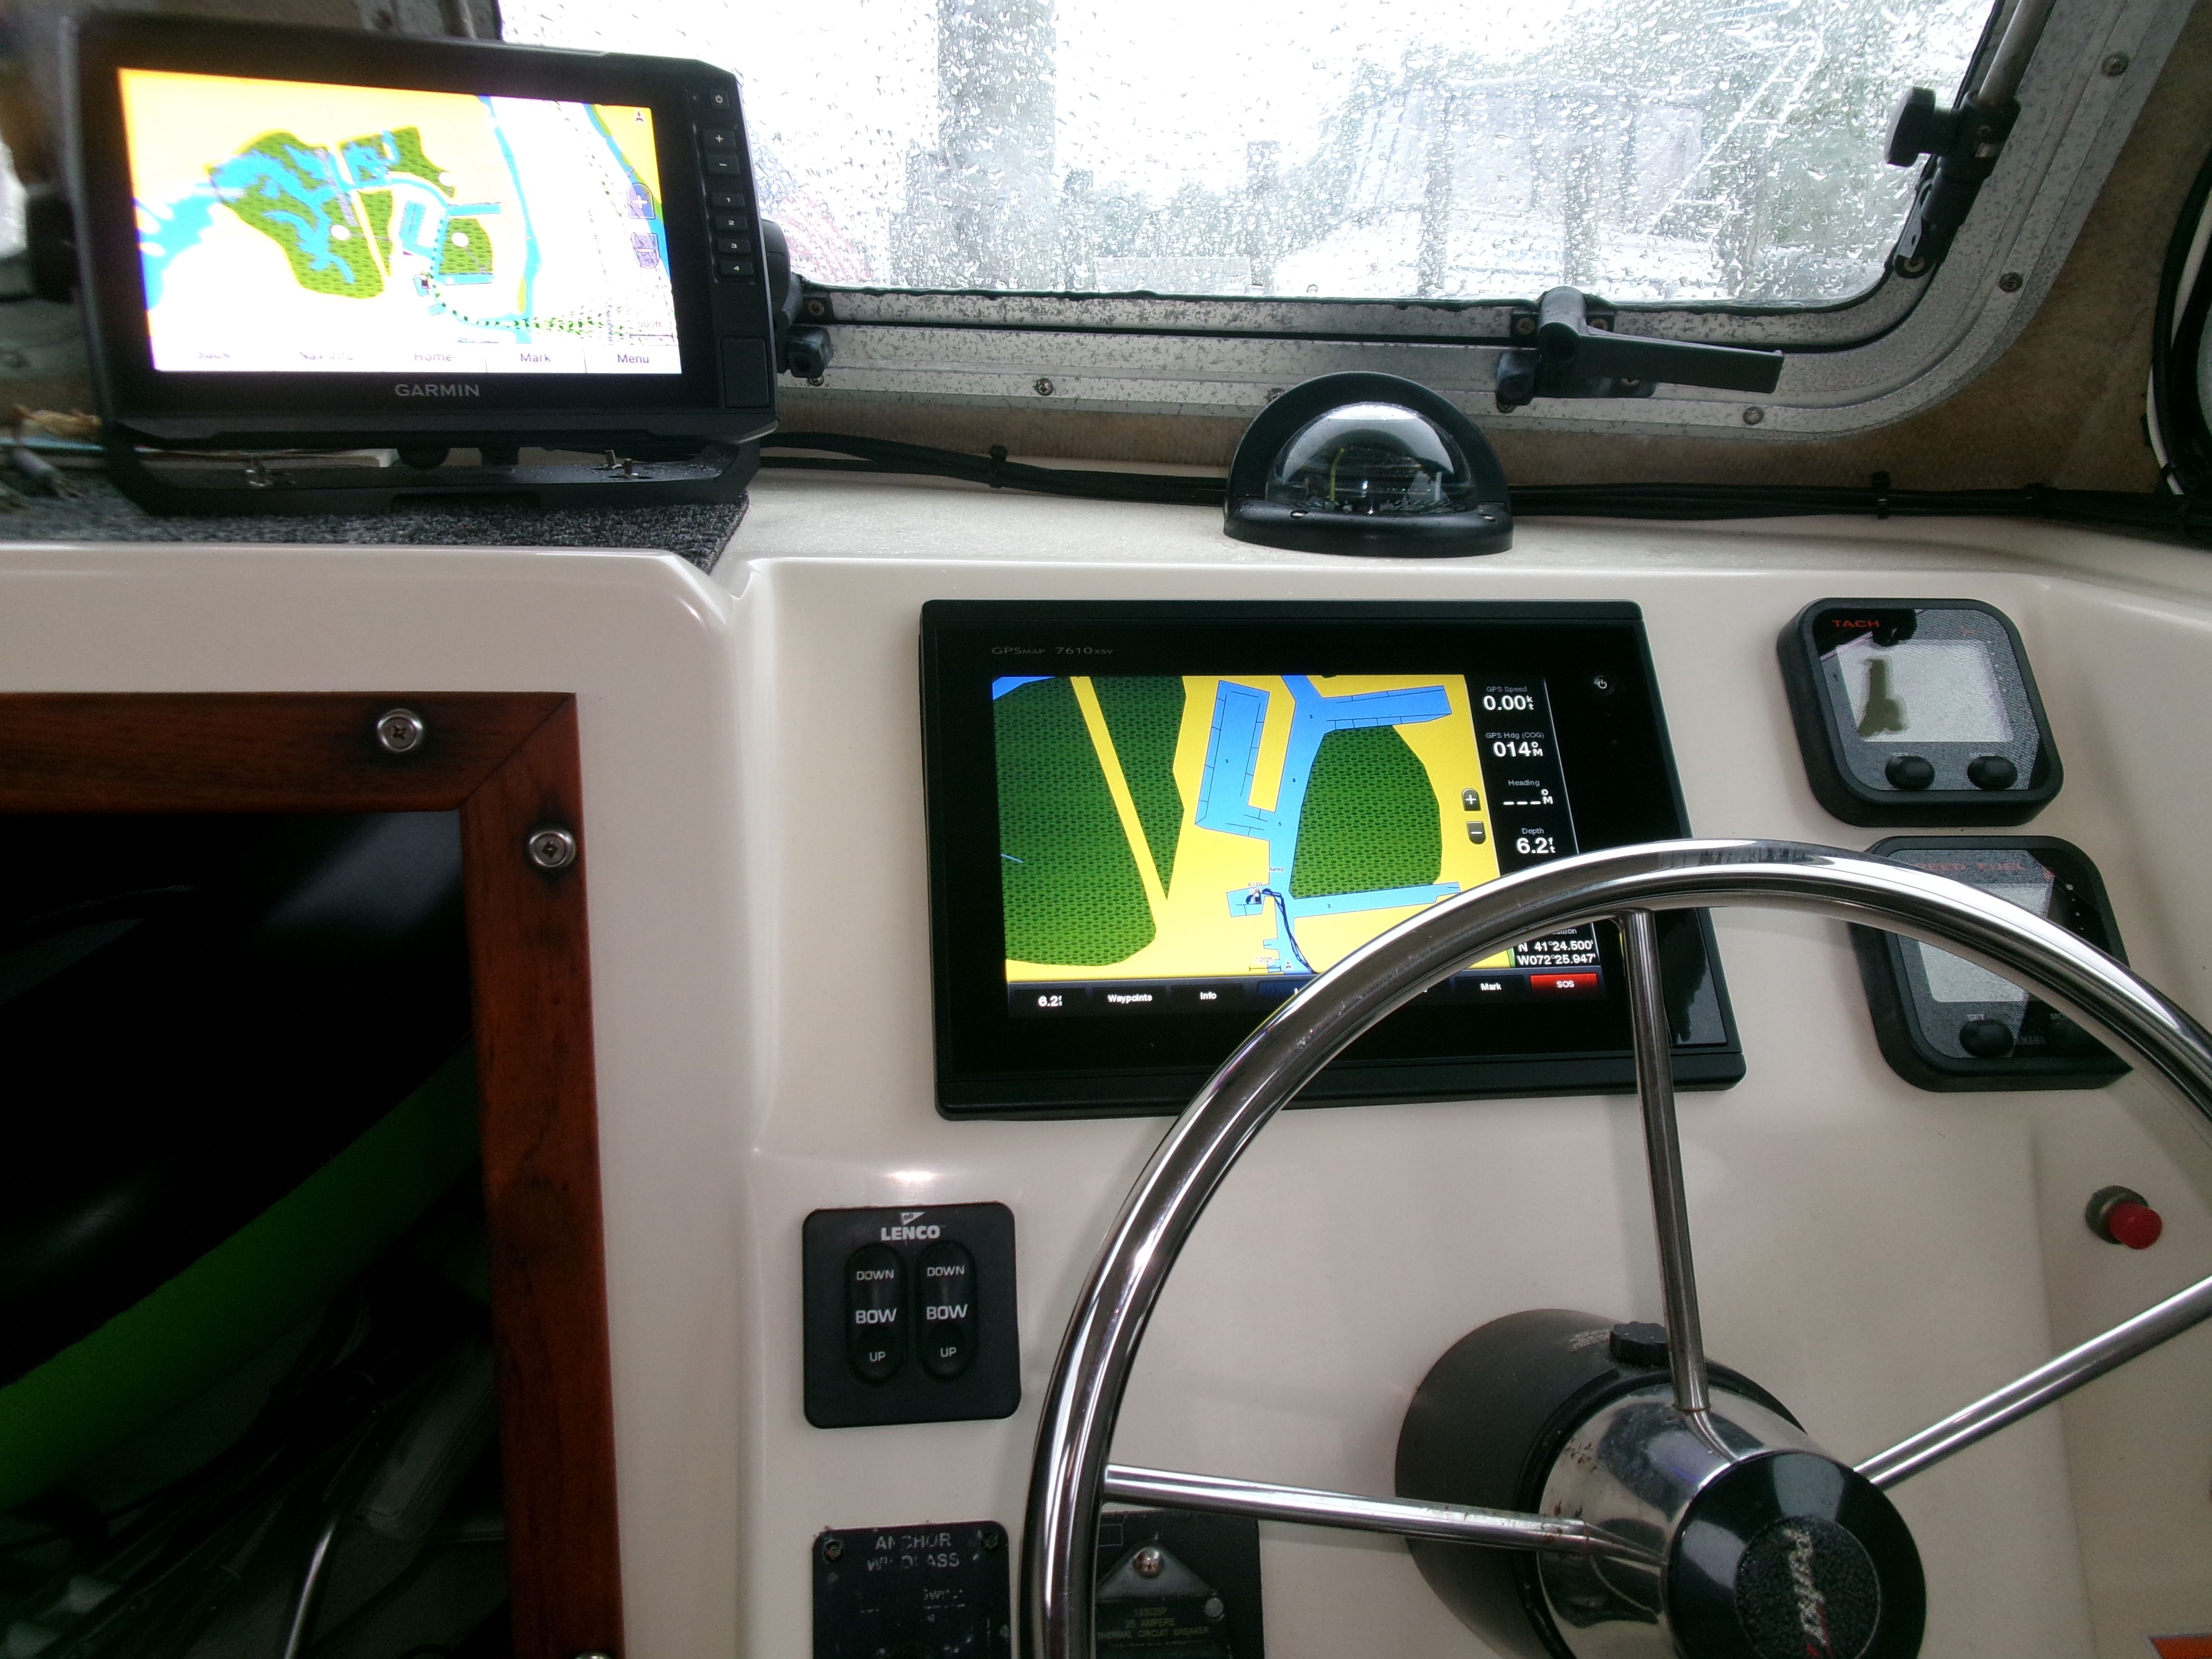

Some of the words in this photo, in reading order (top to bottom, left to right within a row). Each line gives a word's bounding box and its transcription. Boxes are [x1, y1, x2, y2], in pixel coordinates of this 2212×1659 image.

[520, 353, 551, 362] Mark
[617, 354, 649, 363] Menu
[395, 384, 480, 397] GARMIN
[1832, 620, 1879, 628] TACH
[1522, 732, 1544, 740] (COG)
[1522, 828, 1544, 836] Depth
[1518, 942, 1527, 952] N
[1480, 982, 1502, 991] Mark
[1108, 994, 1153, 1003] Waypoints
[1200, 991, 1217, 1000] Info
[881, 1225, 941, 1241] LENCO
[856, 1269, 894, 1280] DOWN
[927, 1264, 965, 1277] DOWN
[855, 1308, 897, 1324] BOW
[926, 1304, 968, 1320] BOW
[869, 1351, 886, 1361] UP
[940, 1346, 957, 1358] UP
